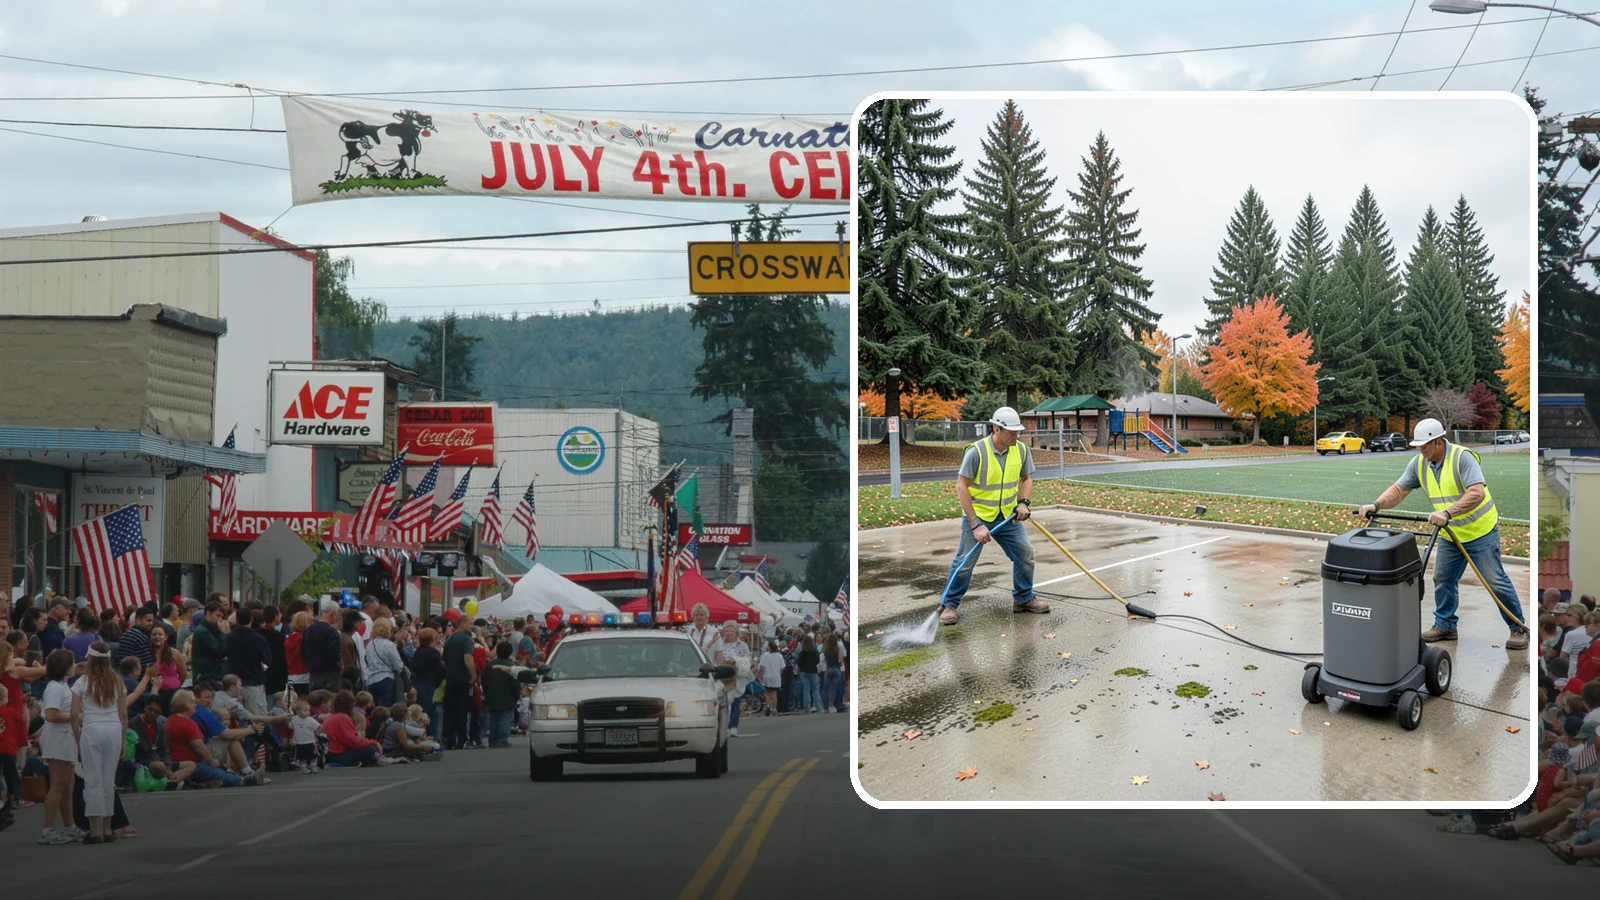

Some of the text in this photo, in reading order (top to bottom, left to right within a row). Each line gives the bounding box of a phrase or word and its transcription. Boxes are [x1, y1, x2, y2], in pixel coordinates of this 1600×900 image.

[481, 141, 604, 193] JULY
[632, 150, 746, 197] 4th.
[697, 254, 850, 280] CROSSWA
[283, 380, 373, 420] ACE
[406, 409, 452, 421] CEDAR
[283, 421, 371, 436] Hardware
[417, 428, 477, 446] Coca-Cola
[96, 485, 124, 494] Vincent
[126, 486, 135, 494] de
[137, 486, 155, 495] Paul
[688, 526, 741, 535] CRNATION
[699, 535, 730, 543] GLASS
